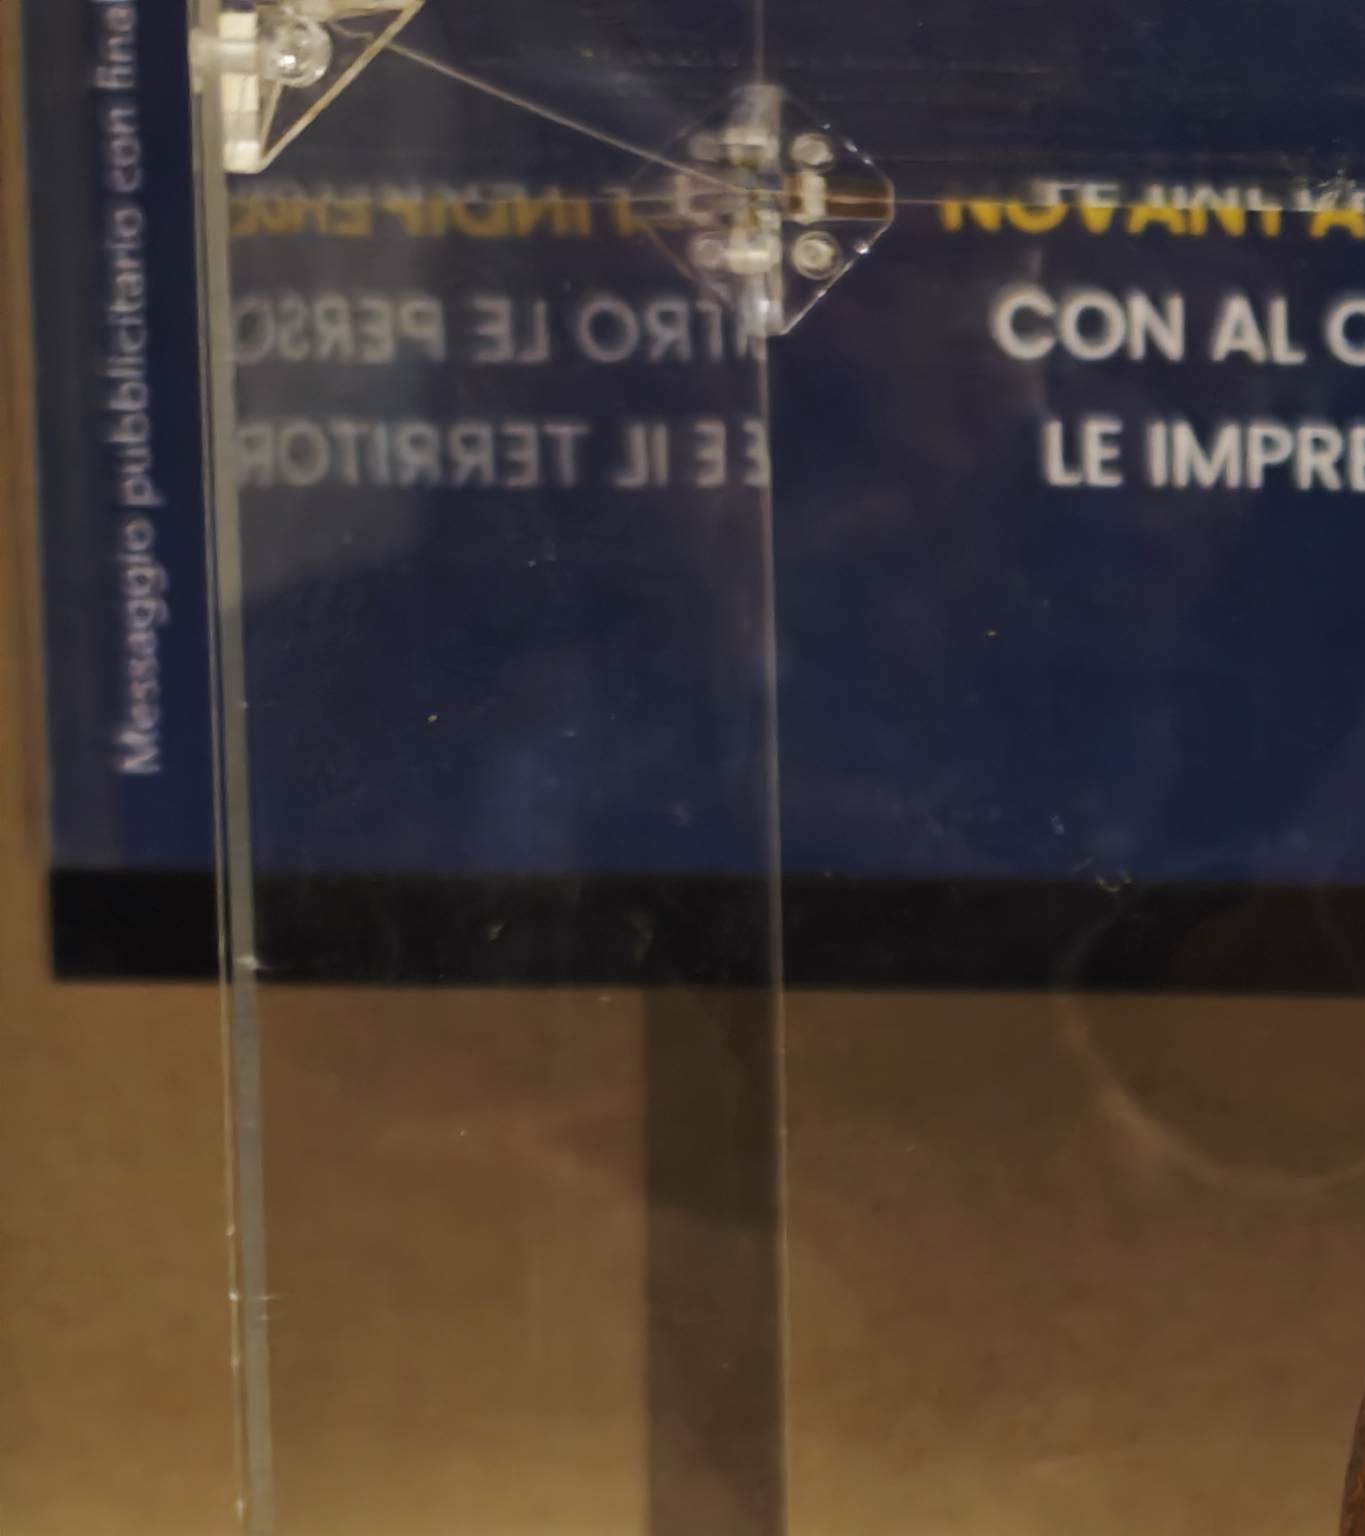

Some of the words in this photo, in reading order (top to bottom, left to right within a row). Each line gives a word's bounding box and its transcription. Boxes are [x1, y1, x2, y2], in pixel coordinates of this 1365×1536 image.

[95, 0, 137, 89] fina
[107, 108, 142, 192] con
[103, 207, 165, 506] pubblicitario
[993, 288, 1185, 361] CON
[1211, 295, 1307, 365] AL
[1045, 418, 1122, 487] LE
[117, 518, 170, 774] Messaggio
